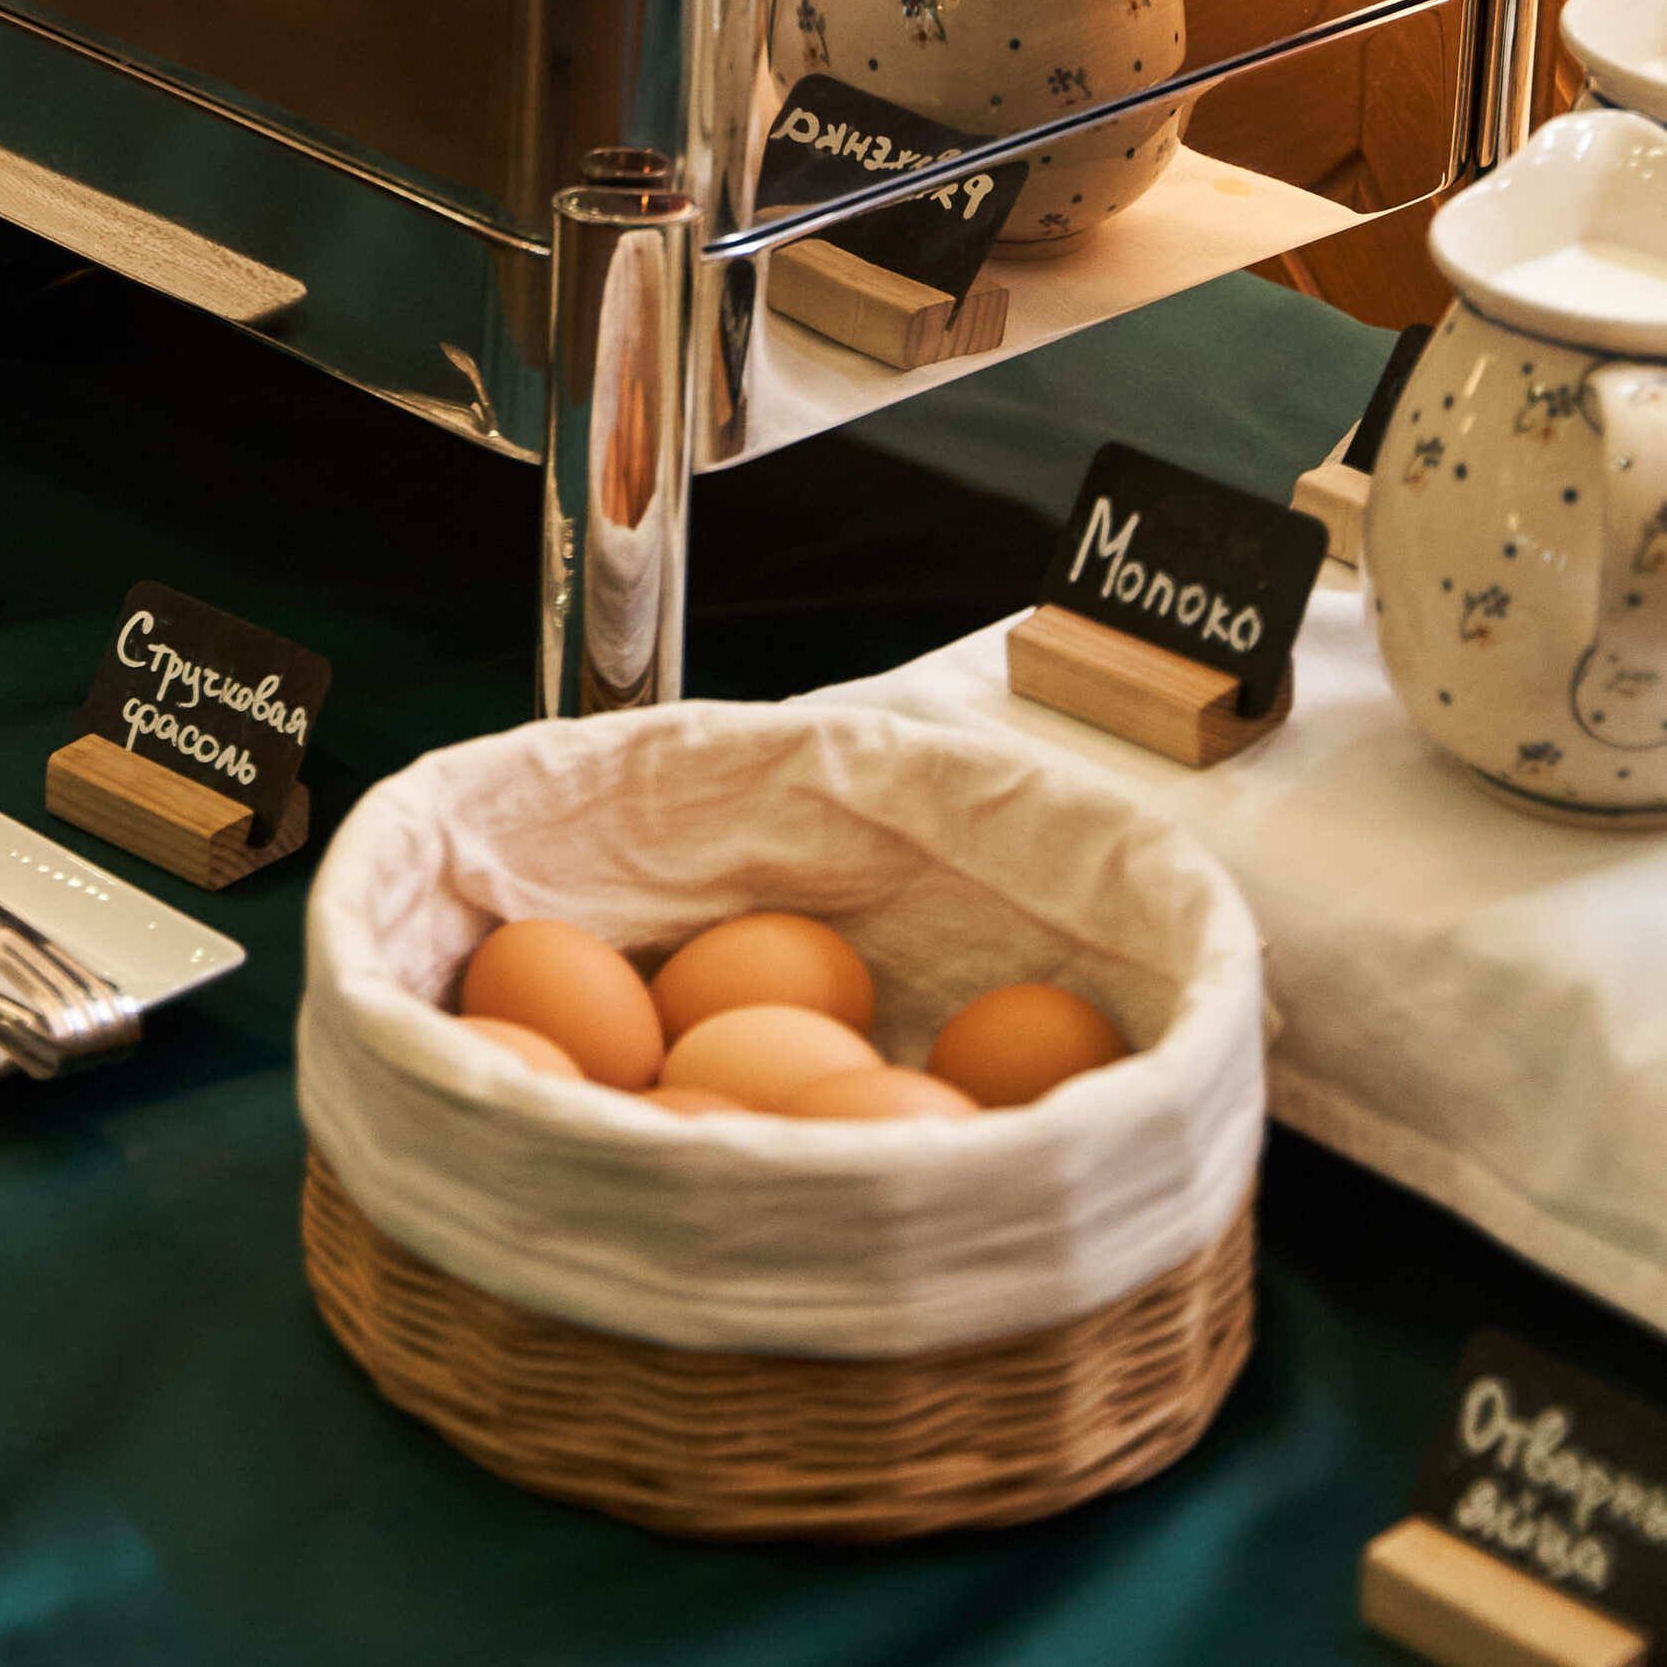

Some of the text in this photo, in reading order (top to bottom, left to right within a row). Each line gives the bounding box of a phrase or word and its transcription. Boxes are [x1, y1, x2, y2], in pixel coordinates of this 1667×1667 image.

[1069, 496, 1264, 654] Молоко
[117, 610, 308, 747] Стручковая
[122, 697, 256, 786] фасоль
